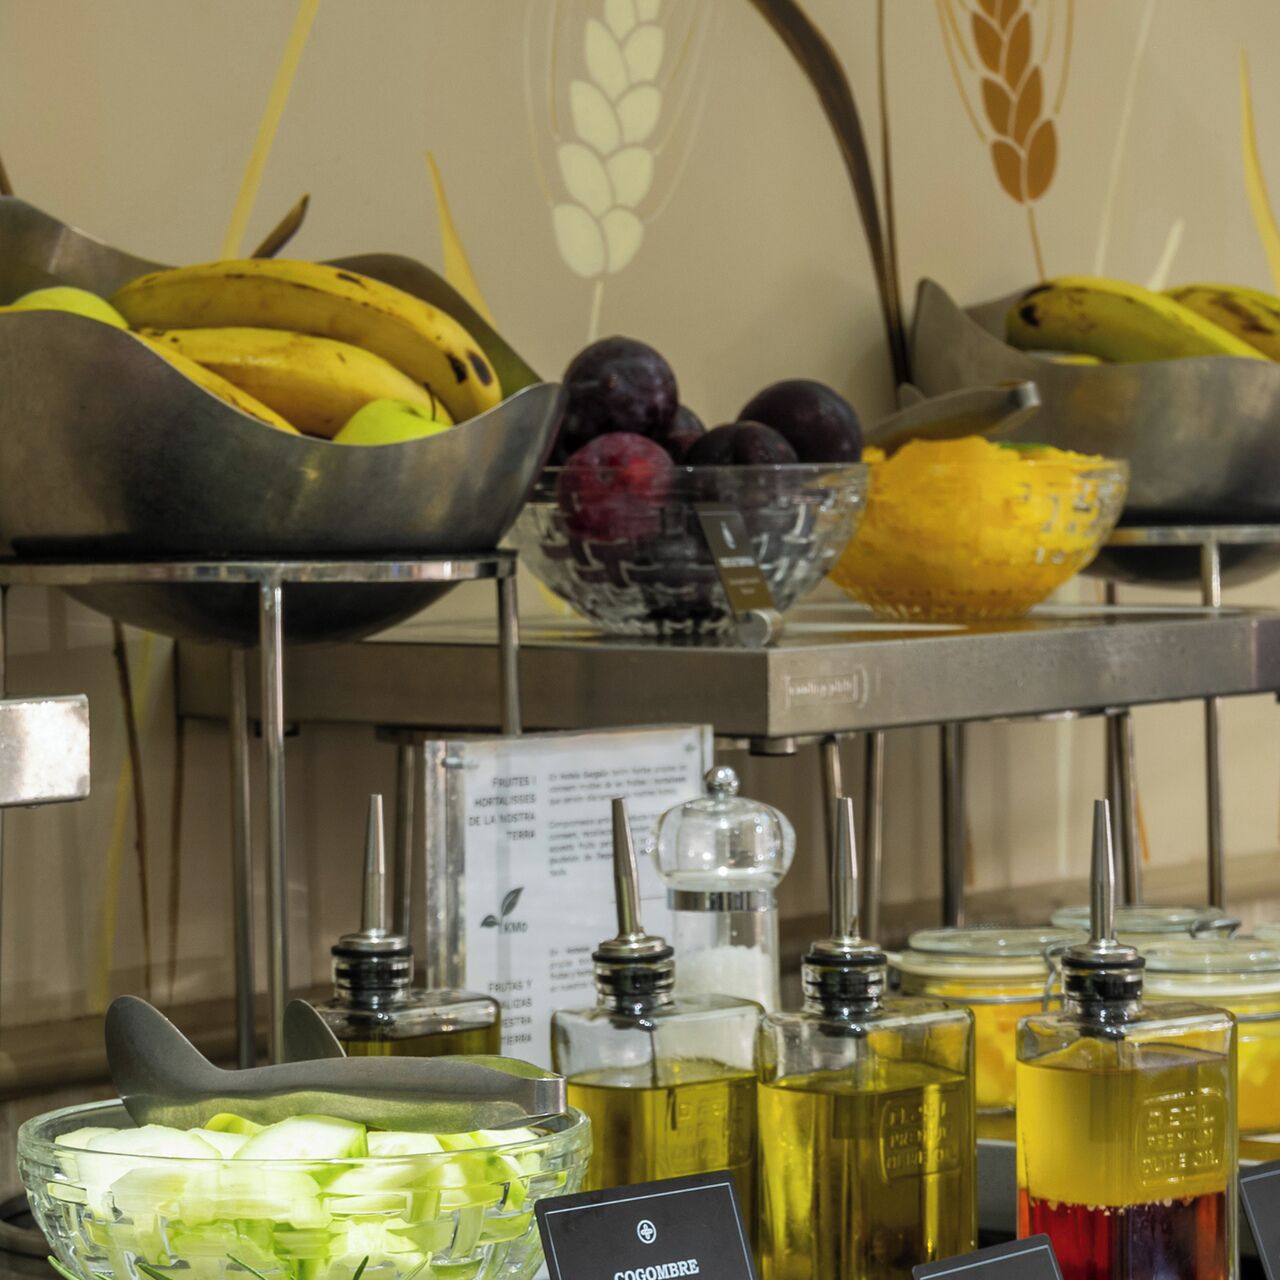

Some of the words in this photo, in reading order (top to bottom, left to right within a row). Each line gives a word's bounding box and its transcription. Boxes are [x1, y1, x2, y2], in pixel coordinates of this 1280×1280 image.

[492, 776, 530, 789] FRUITES
[474, 794, 535, 808] HORTALISSES
[468, 816, 480, 827] DE
[483, 815, 496, 826] LA
[499, 813, 535, 825] NOSTRA
[506, 830, 535, 841] TERRA
[489, 980, 523, 992] FRUTAS
